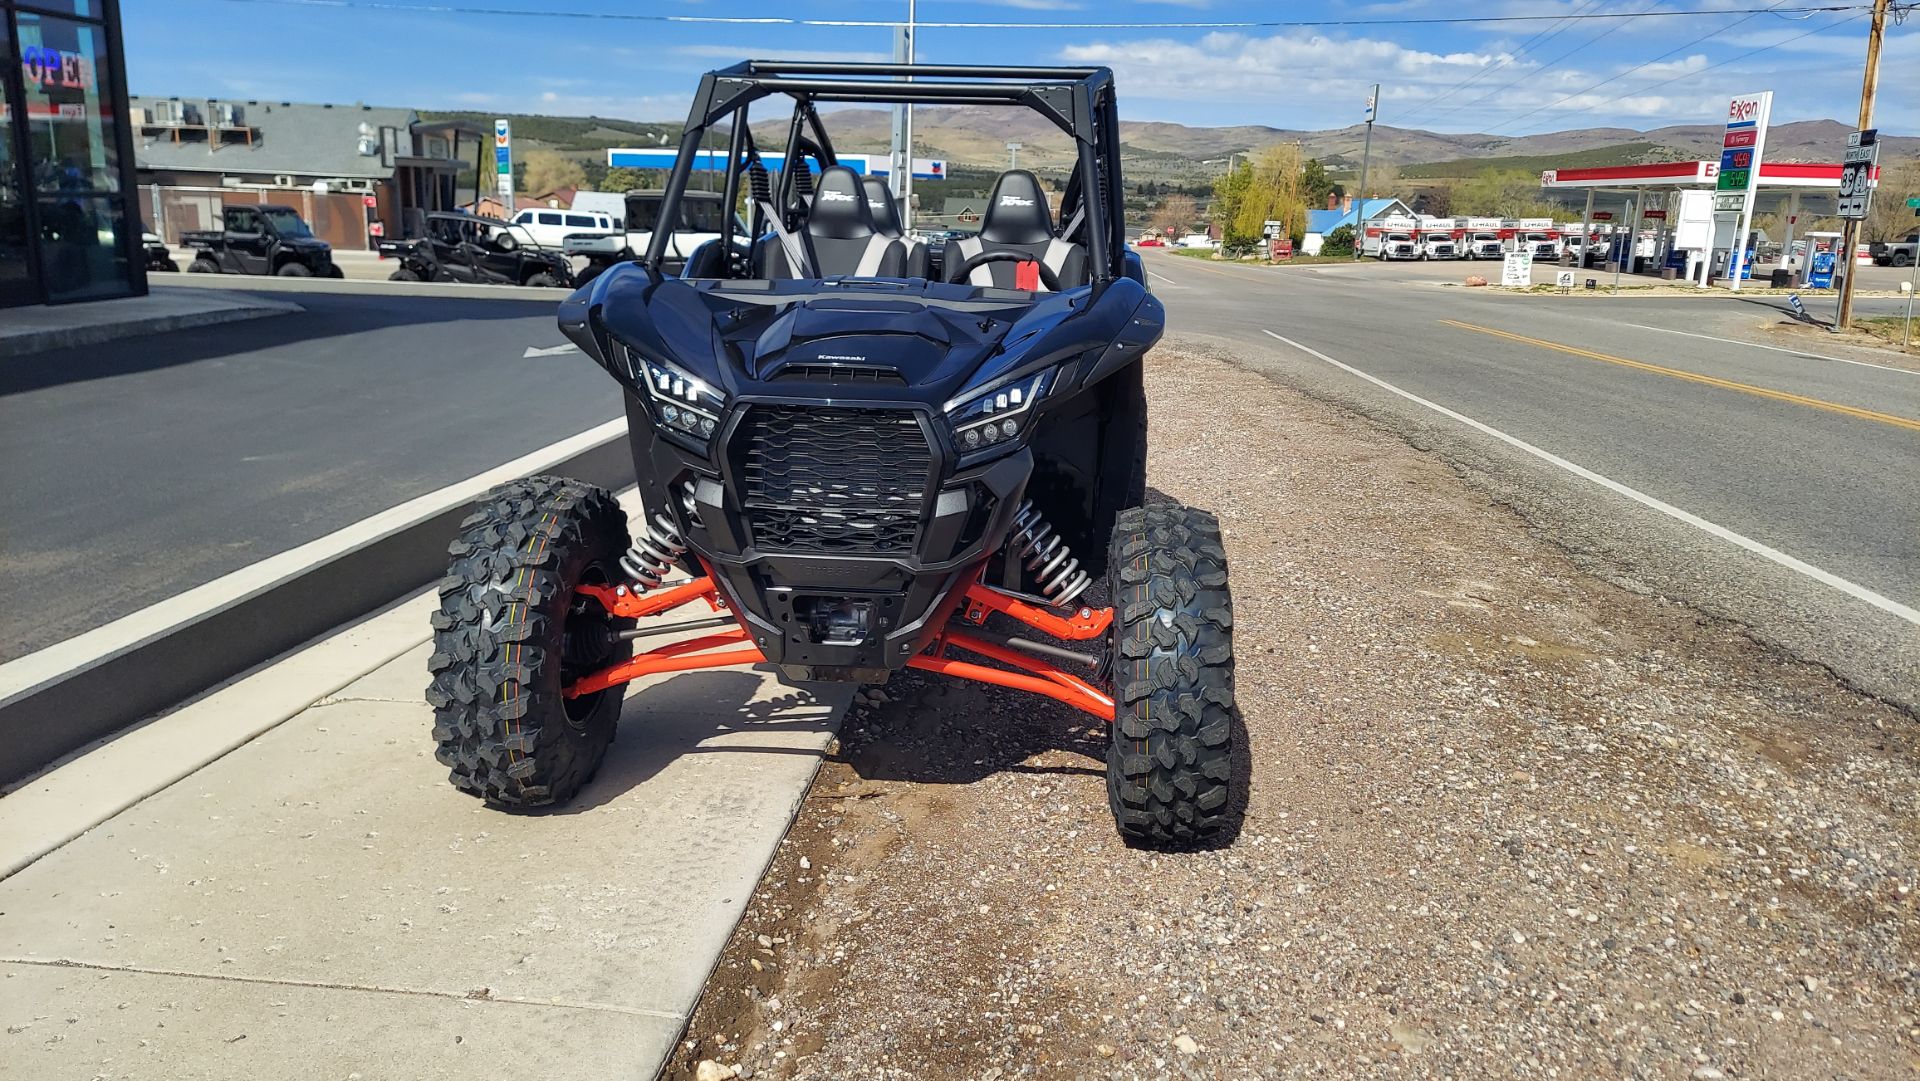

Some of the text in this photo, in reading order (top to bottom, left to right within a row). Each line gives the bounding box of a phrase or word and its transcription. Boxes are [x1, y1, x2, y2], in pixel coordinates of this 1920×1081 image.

[22, 46, 93, 89] OPEN
[1730, 100, 1758, 120] Exxon
[1851, 135, 1858, 144] TO
[1860, 149, 1871, 159] EAST
[1841, 173, 1854, 189] 89
